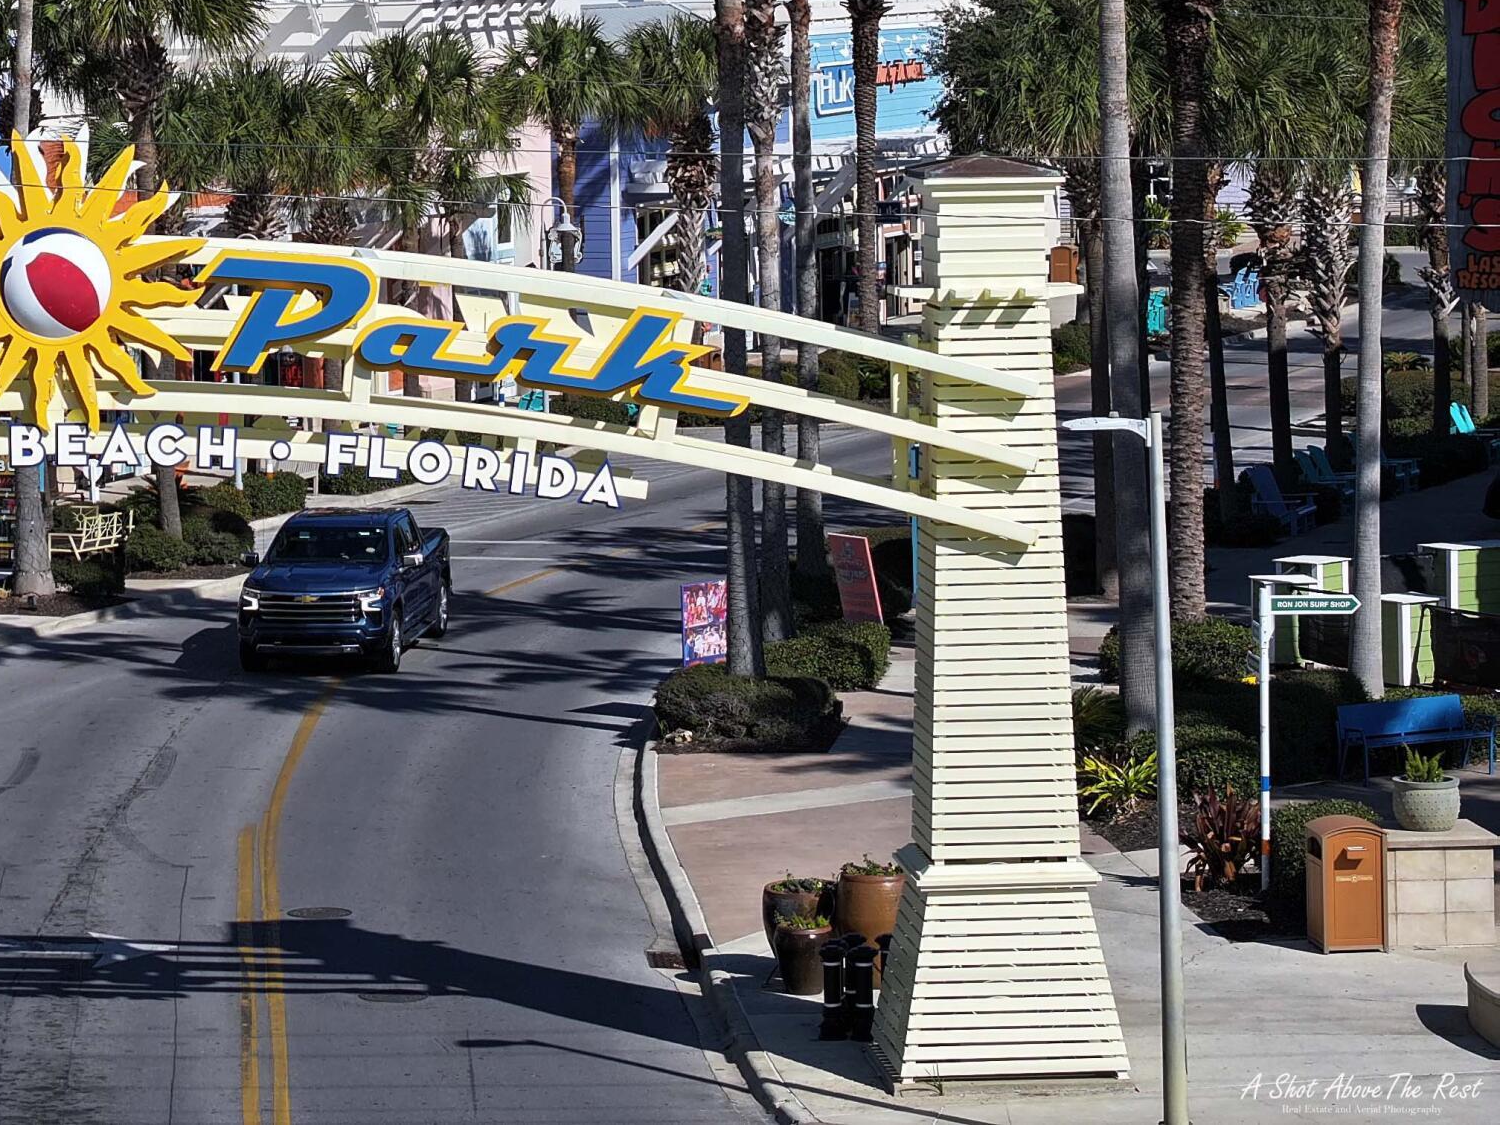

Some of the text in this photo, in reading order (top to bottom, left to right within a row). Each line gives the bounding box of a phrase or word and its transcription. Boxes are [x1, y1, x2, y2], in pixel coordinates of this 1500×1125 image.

[194, 249, 750, 418] Park
[8, 421, 238, 471] BEACH
[325, 431, 622, 509] FLORIDA
